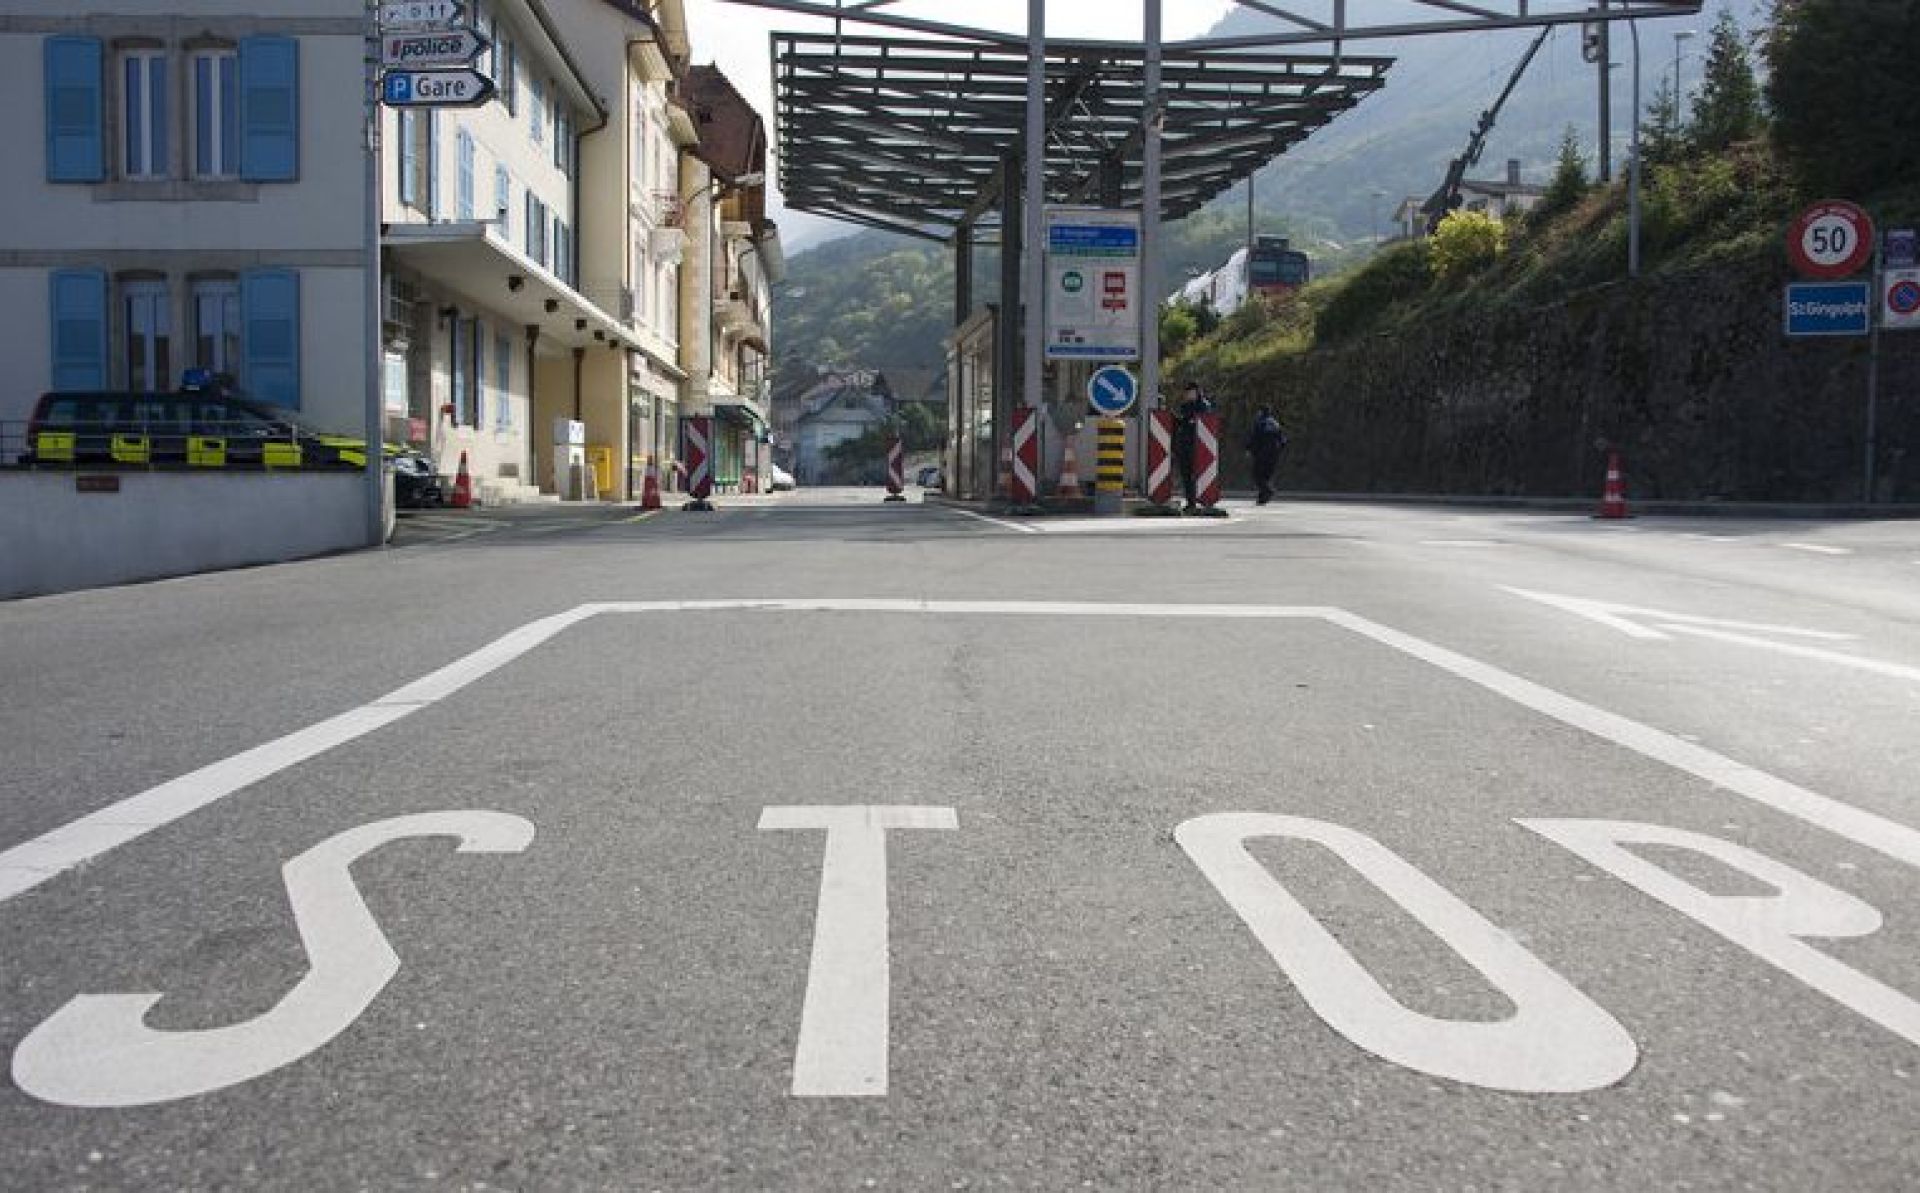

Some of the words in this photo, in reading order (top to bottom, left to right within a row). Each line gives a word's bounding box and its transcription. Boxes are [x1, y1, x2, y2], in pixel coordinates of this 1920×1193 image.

[400, 37, 462, 60] police
[416, 77, 466, 97] Gare
[1812, 225, 1846, 254] 50
